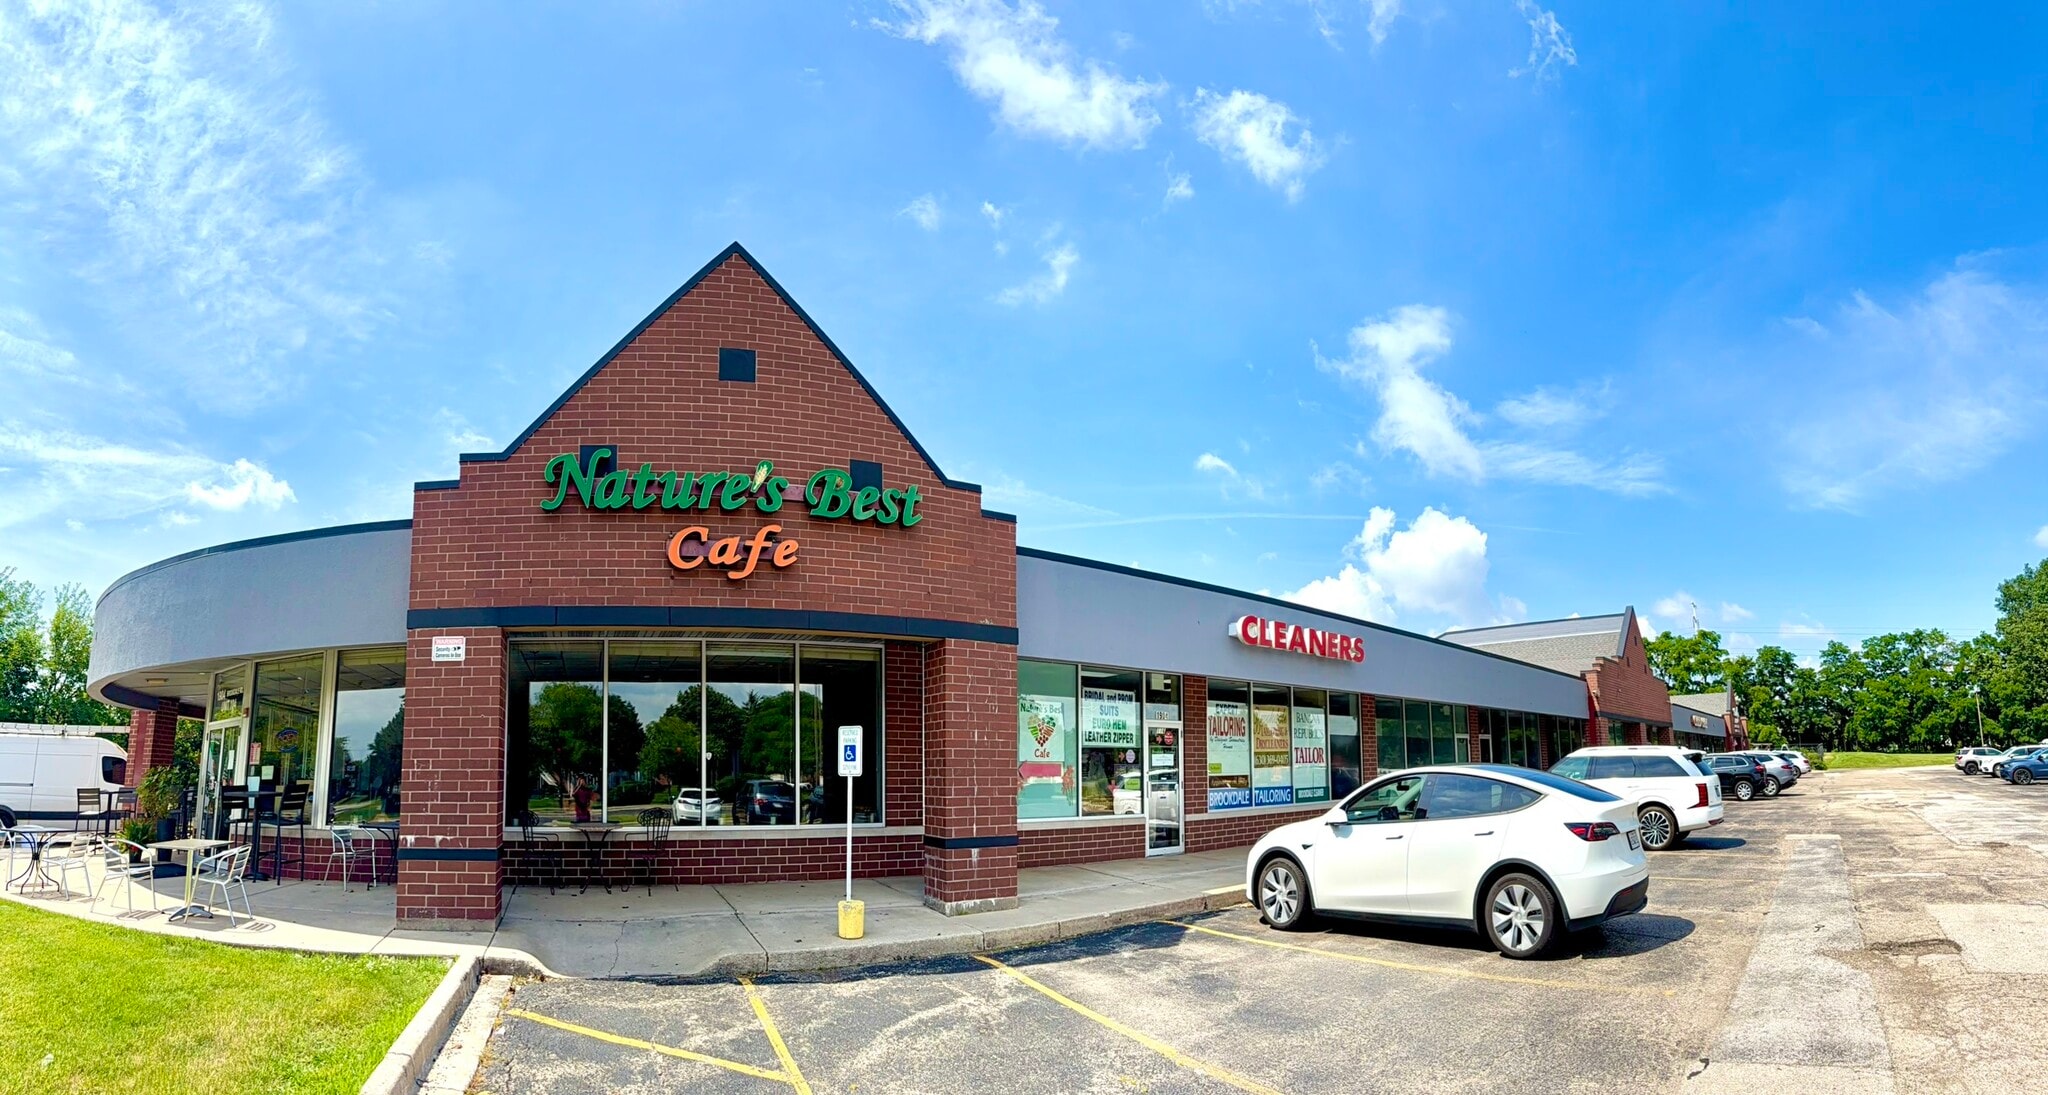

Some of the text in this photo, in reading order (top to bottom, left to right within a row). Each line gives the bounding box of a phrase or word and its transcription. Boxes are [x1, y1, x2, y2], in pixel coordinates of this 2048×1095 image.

[540, 447, 923, 527] Nature's Best
[667, 524, 799, 580] Cafe
[1236, 614, 1366, 663] CLEANERS
[1084, 690, 1105, 702] BRIDAL
[1106, 693, 1117, 702] and
[1099, 705, 1120, 717] SUITS
[1215, 703, 1239, 715] EXPERT
[1208, 714, 1246, 737] TAILORING
[1084, 730, 1135, 744] LEATHER ZIPPER
[1034, 747, 1051, 759] Cafe
[1293, 746, 1325, 764] TAILOR
[1209, 788, 1292, 806] BROOKDALE TAILORING
